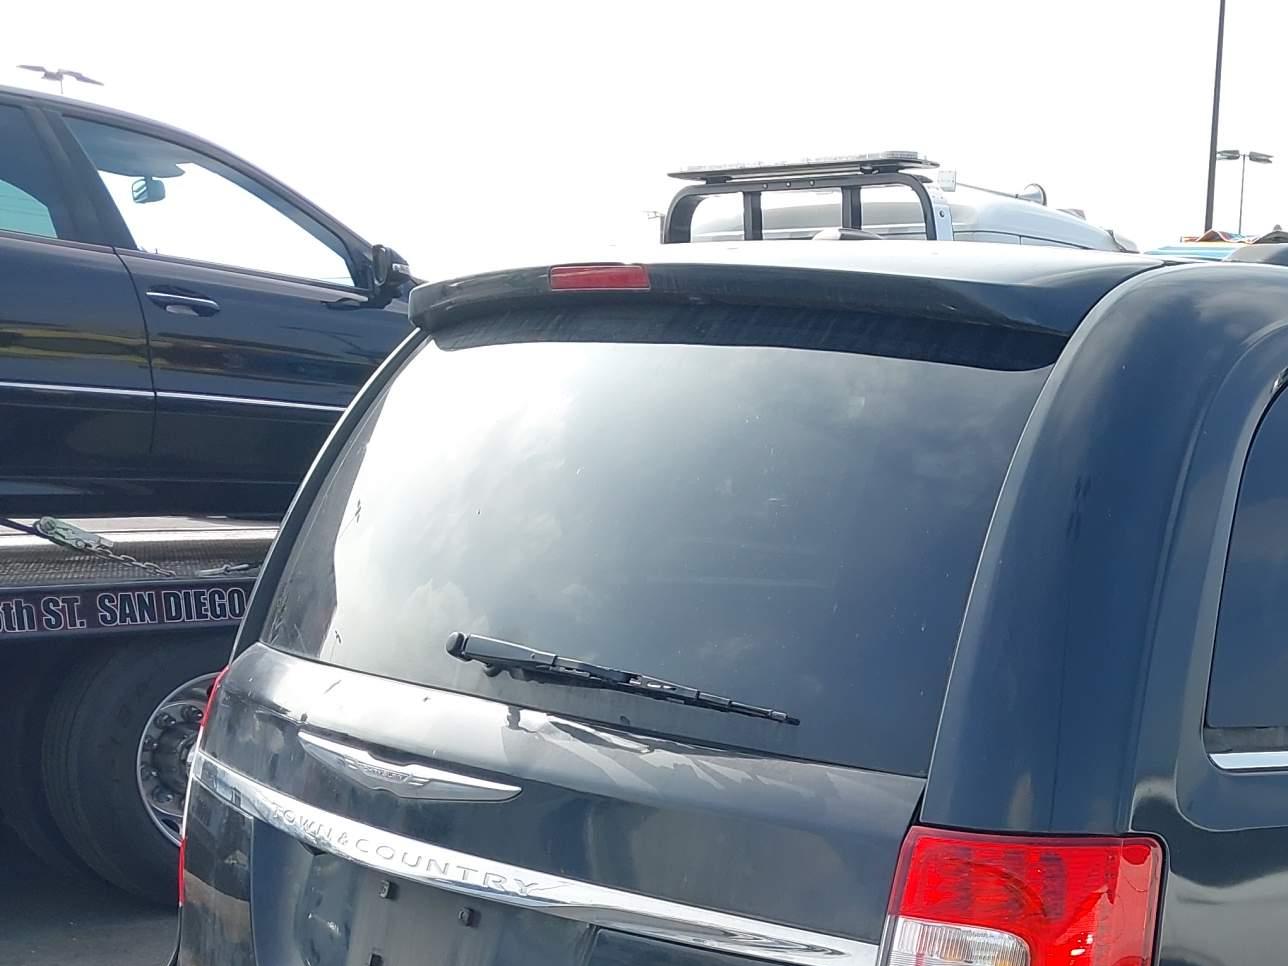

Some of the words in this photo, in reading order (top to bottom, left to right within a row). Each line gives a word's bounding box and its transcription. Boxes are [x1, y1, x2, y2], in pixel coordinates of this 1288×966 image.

[0, 599, 37, 633] th
[41, 595, 87, 631] ST.
[97, 591, 158, 627] SAN
[162, 587, 247, 623] DIEGO
